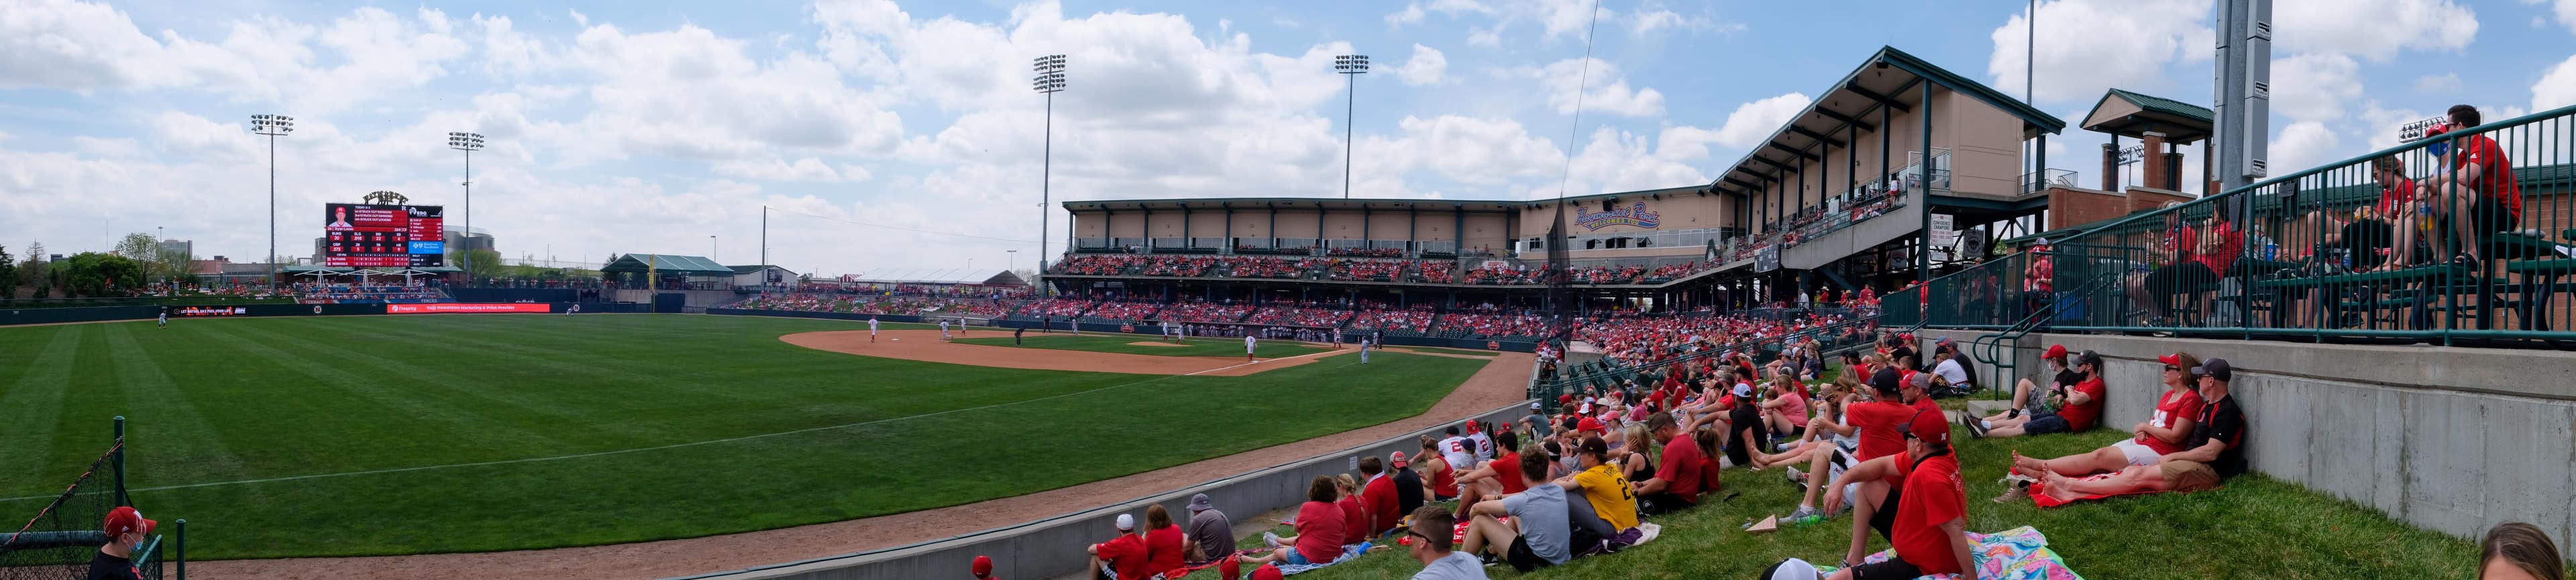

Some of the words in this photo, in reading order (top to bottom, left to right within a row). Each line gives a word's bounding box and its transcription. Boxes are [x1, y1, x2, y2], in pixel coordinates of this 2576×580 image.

[1574, 207, 1631, 226] Haymarket
[1633, 201, 1660, 224] Park
[1591, 218, 1625, 228] WELCOMES
